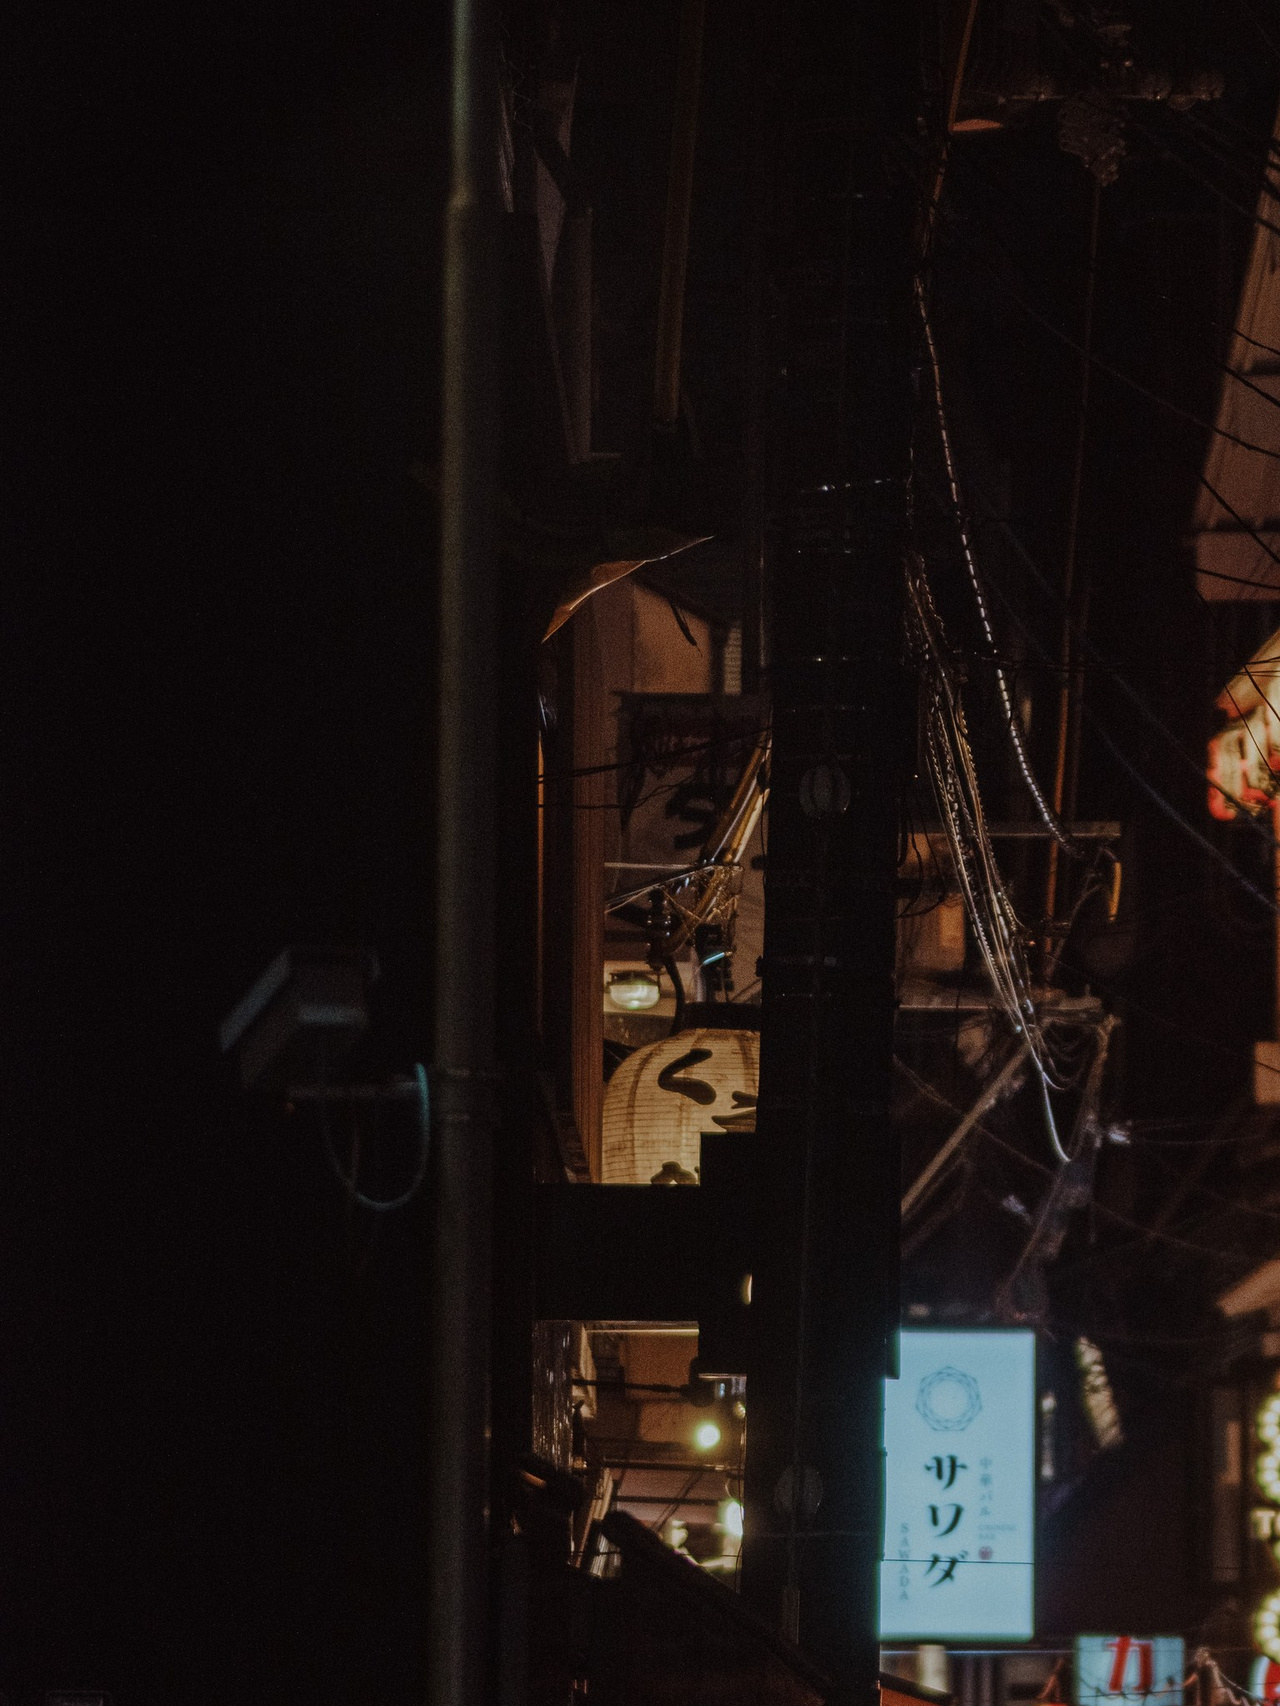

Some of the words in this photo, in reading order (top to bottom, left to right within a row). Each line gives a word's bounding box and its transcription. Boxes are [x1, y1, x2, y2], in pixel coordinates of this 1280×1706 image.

[899, 1522, 911, 1602] SAWADA
[923, 1454, 969, 1588] サワダ
